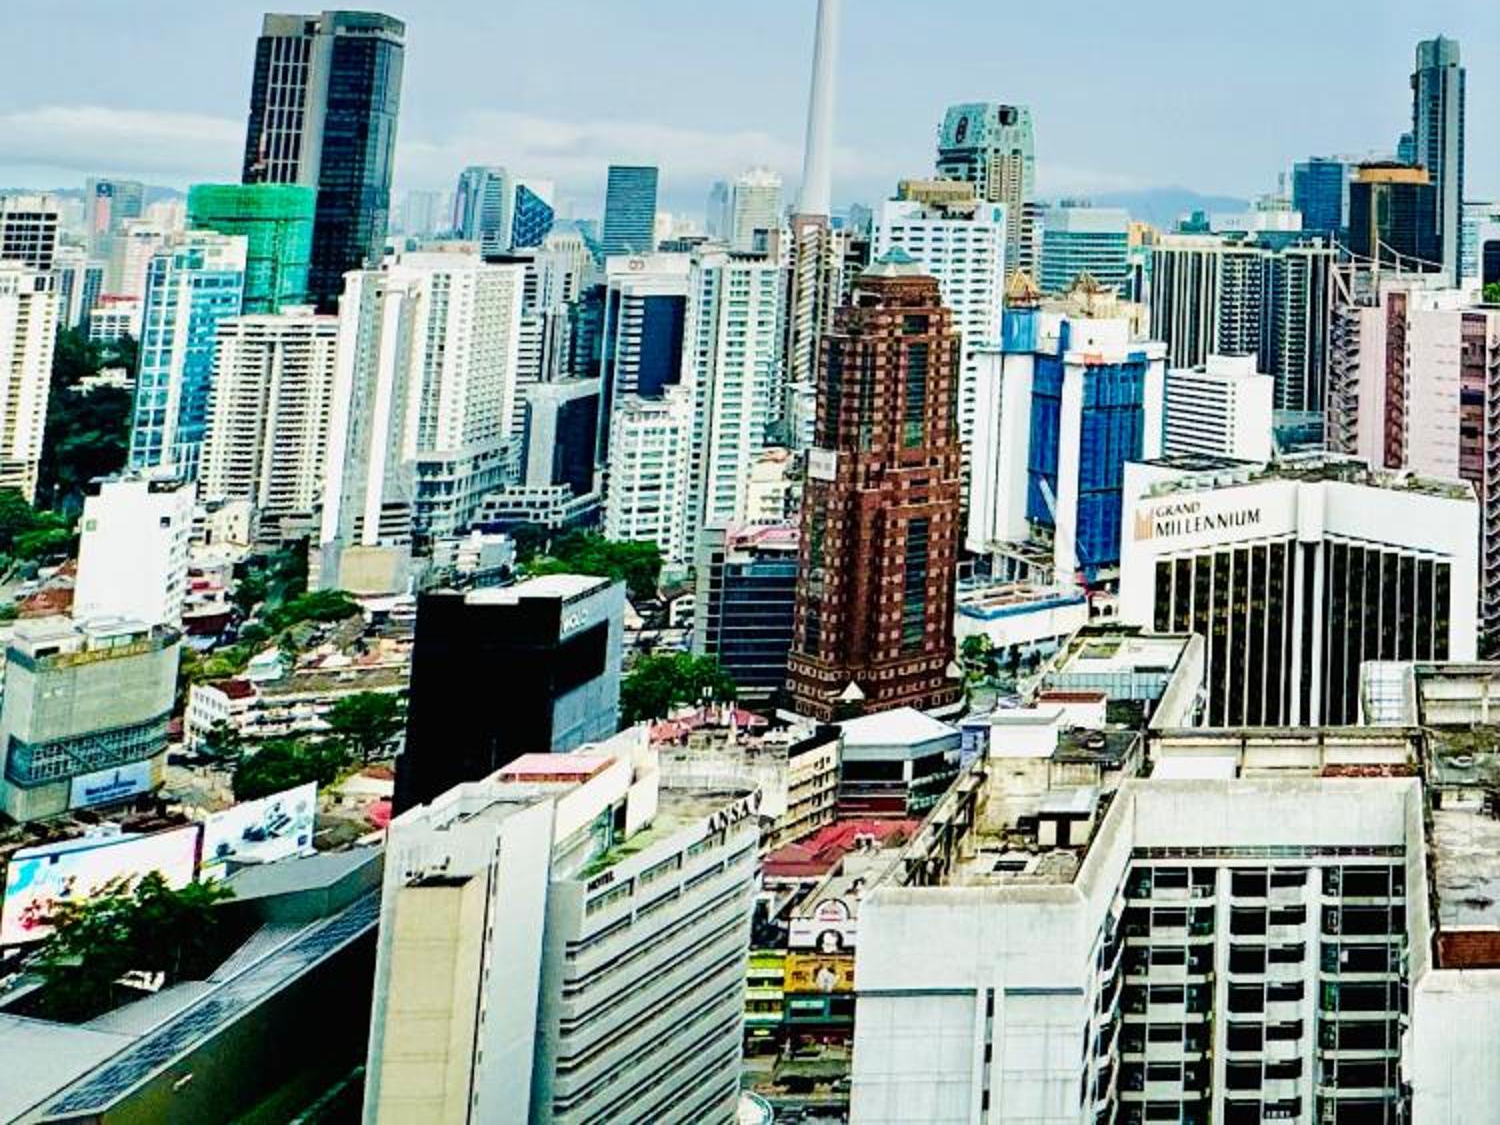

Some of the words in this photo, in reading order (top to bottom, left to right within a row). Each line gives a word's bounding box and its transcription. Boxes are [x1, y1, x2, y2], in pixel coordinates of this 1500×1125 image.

[1155, 501, 1201, 518] GRAND
[1155, 508, 1261, 537] MILLENNIUM
[706, 797, 750, 835] ANSA
[587, 871, 615, 893] HOTEL
